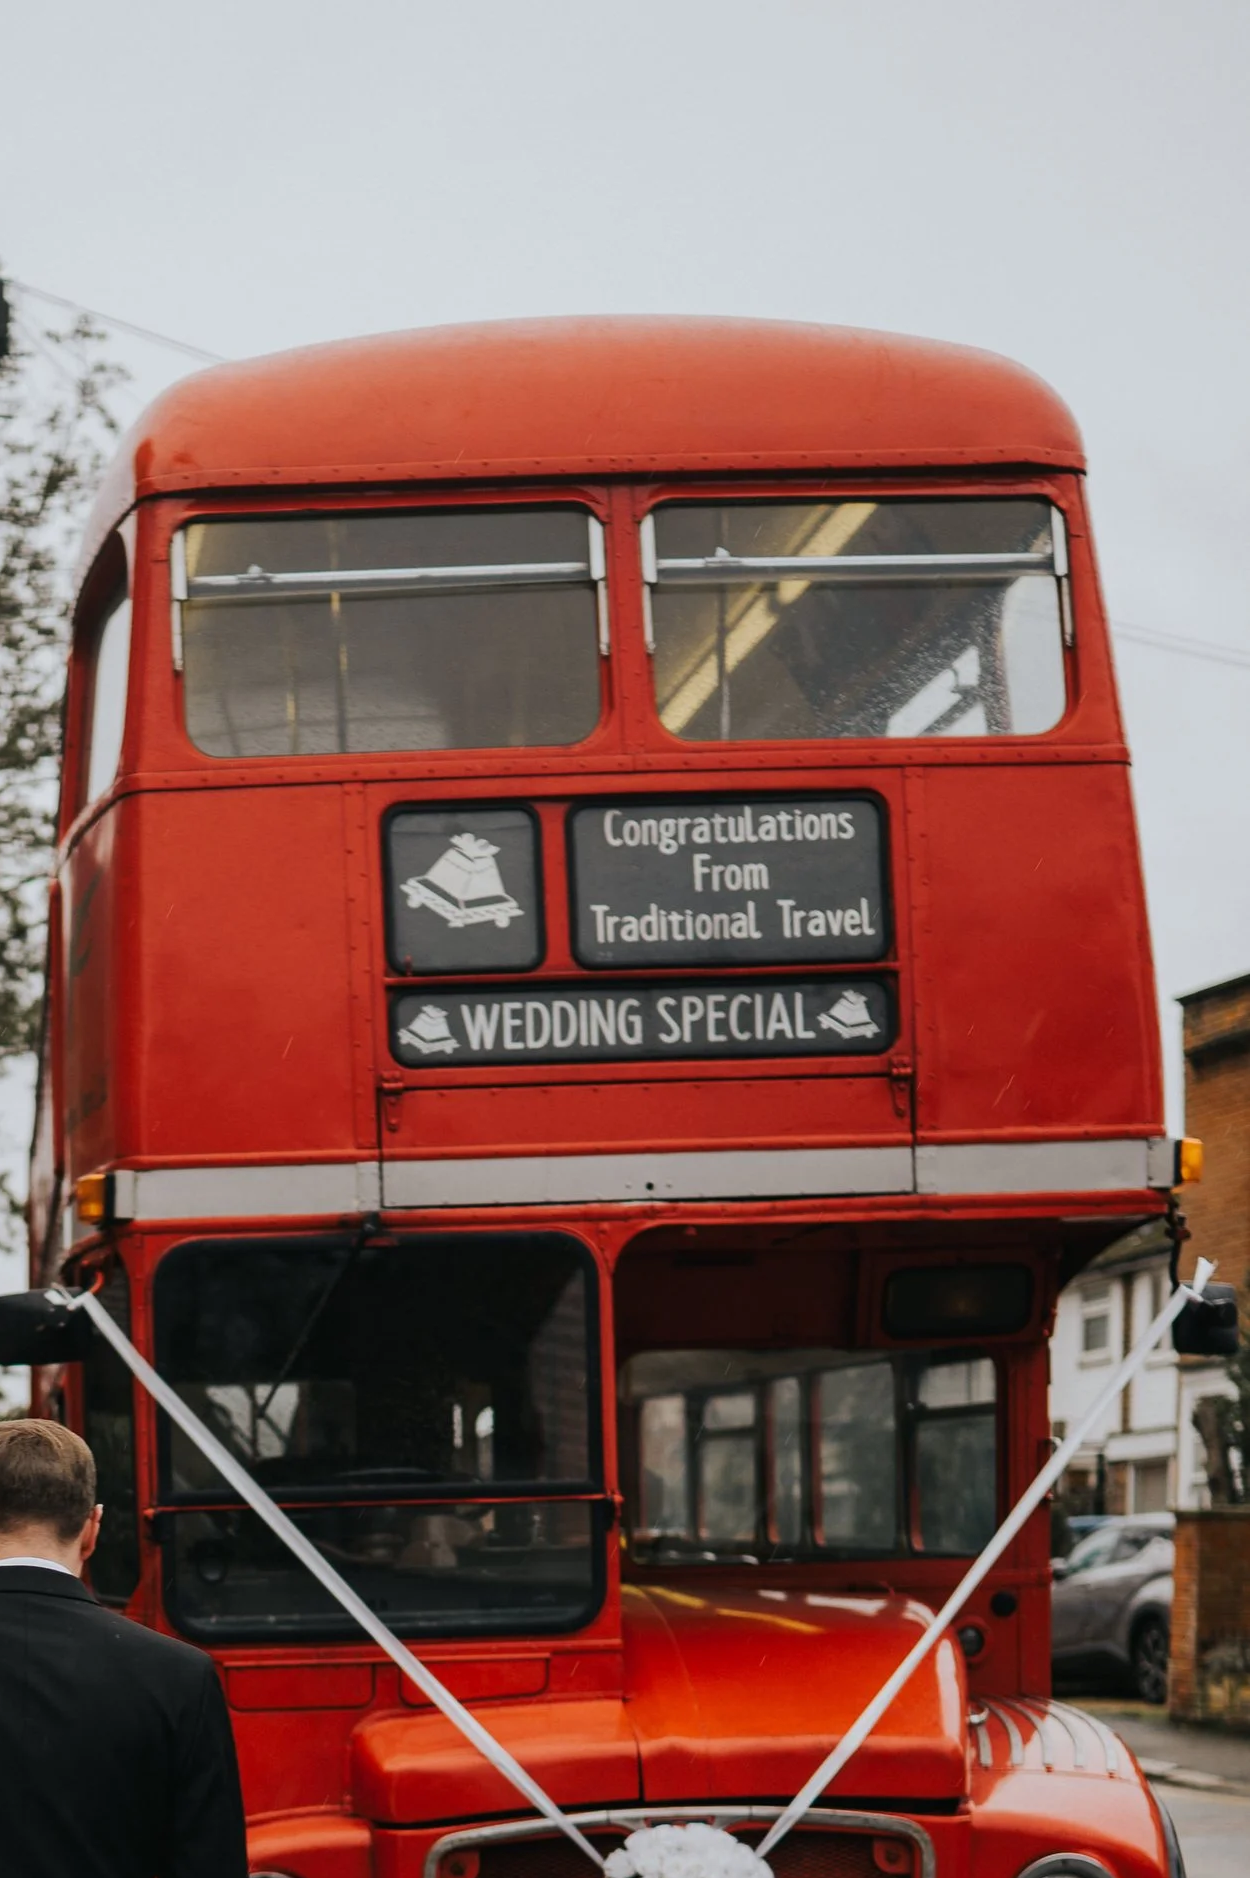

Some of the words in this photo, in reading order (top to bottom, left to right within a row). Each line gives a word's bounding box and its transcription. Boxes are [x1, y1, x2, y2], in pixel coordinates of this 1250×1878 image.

[603, 805, 856, 855] Congratulations
[692, 853, 770, 892] From
[589, 901, 763, 944] Traditional
[776, 897, 876, 939] Travel
[459, 998, 643, 1051] WEDDING
[656, 992, 816, 1044] SPECIAL
